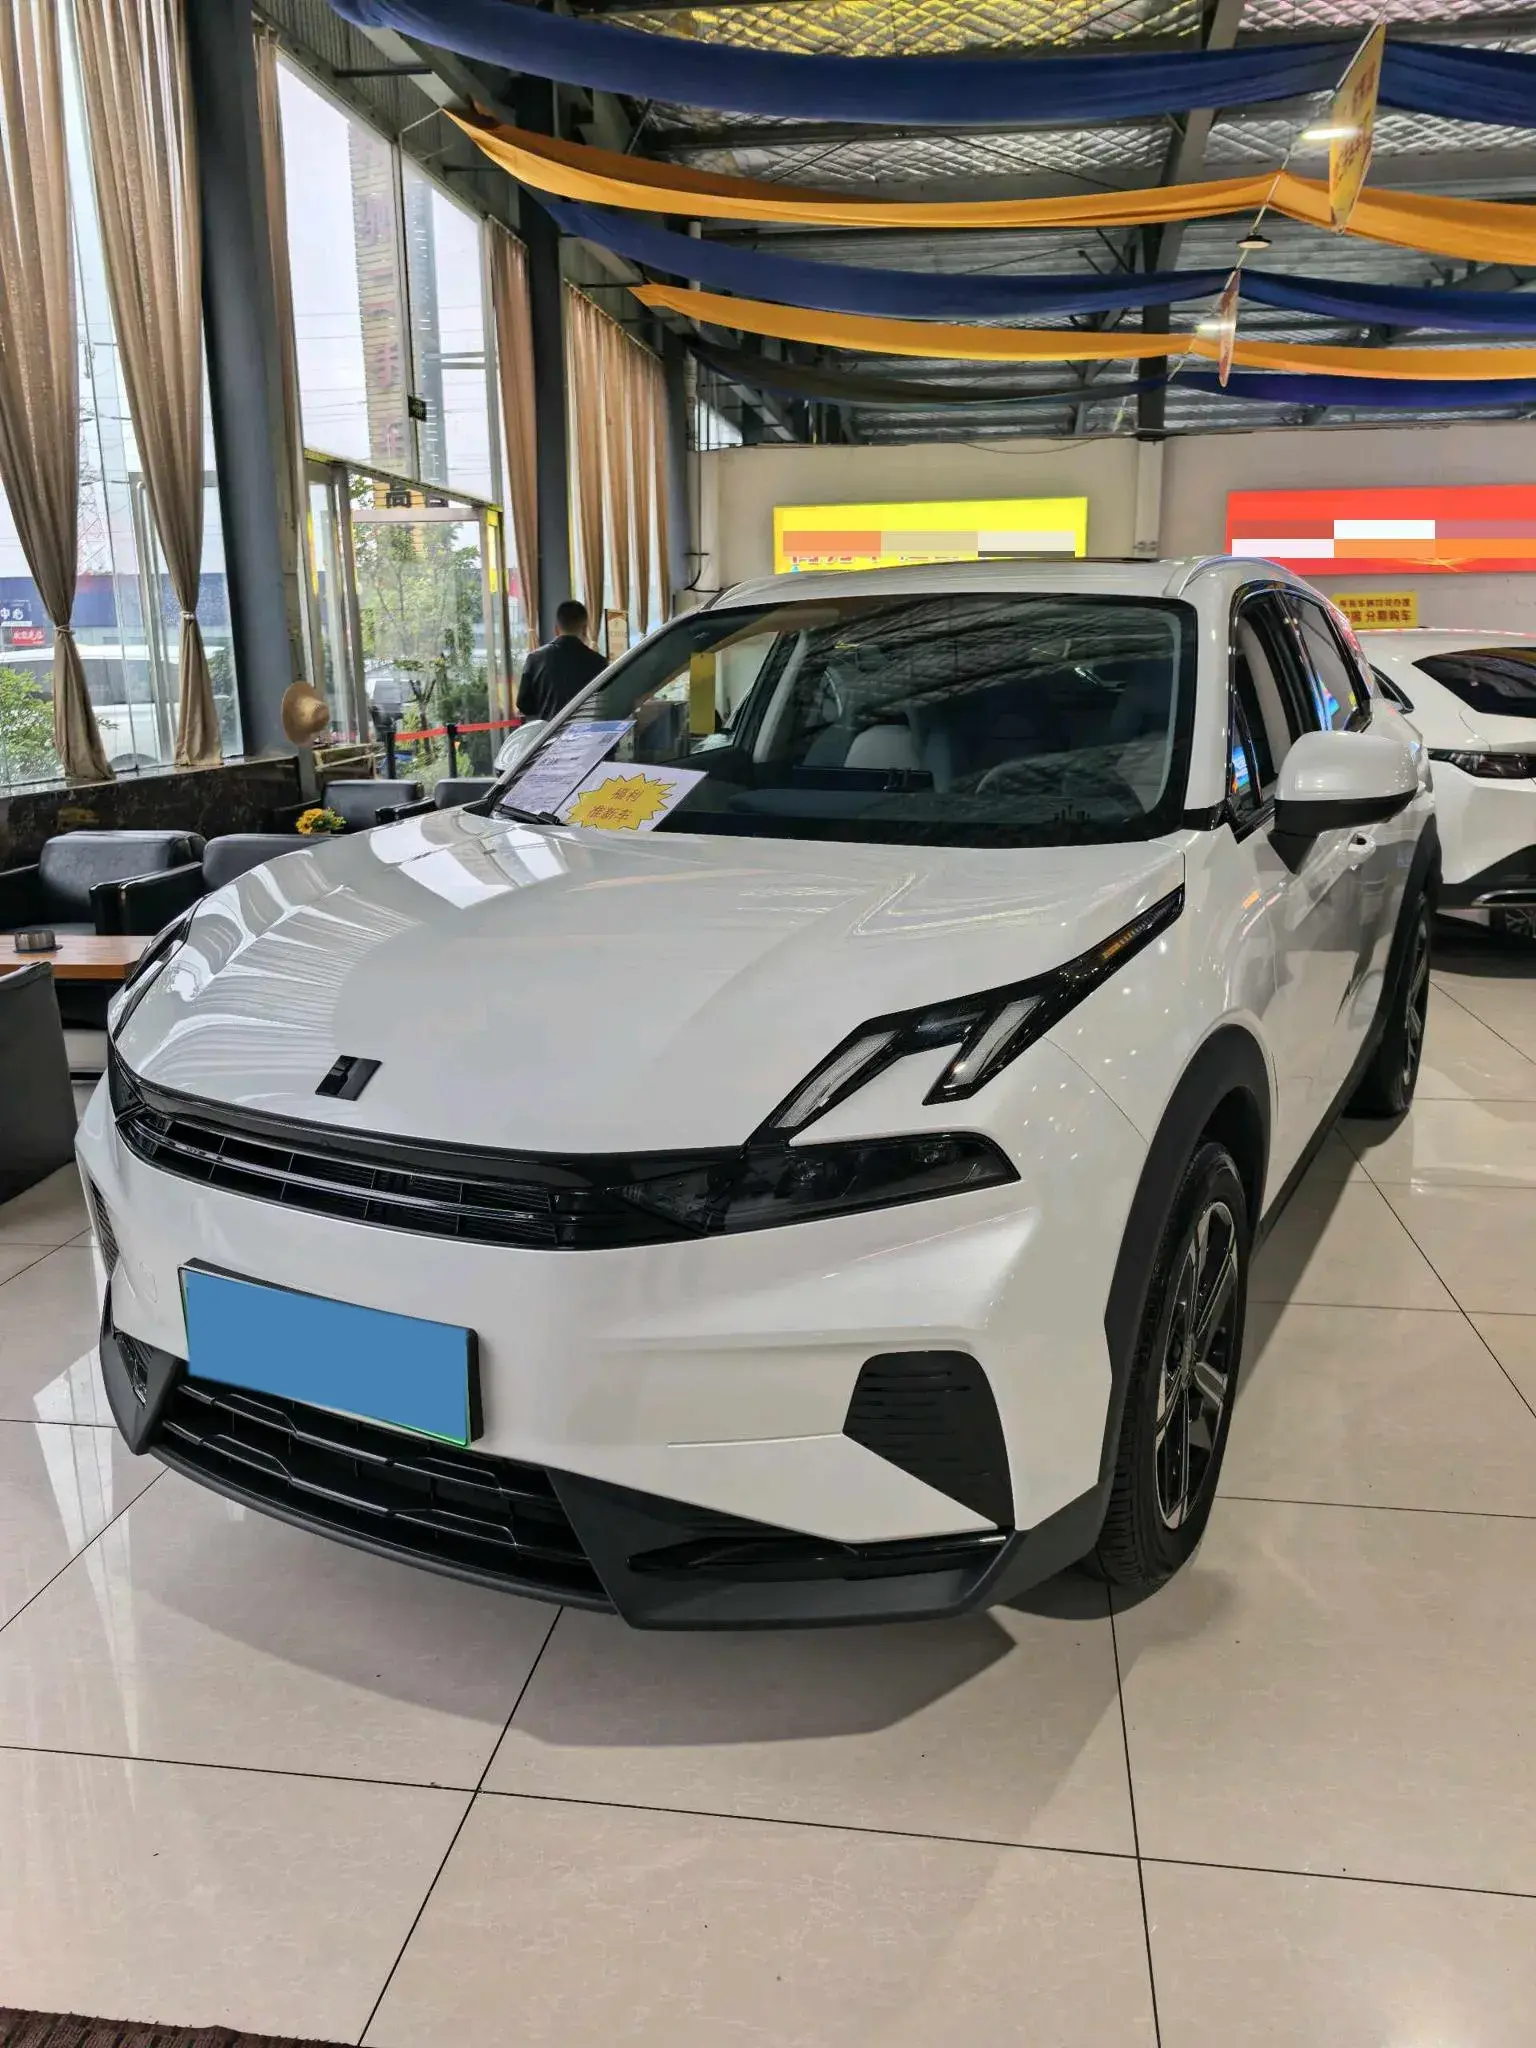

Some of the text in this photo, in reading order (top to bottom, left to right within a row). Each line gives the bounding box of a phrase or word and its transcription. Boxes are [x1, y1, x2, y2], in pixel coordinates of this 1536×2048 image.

[611, 787, 645, 802] 福利
[588, 804, 633, 821] 准新车
